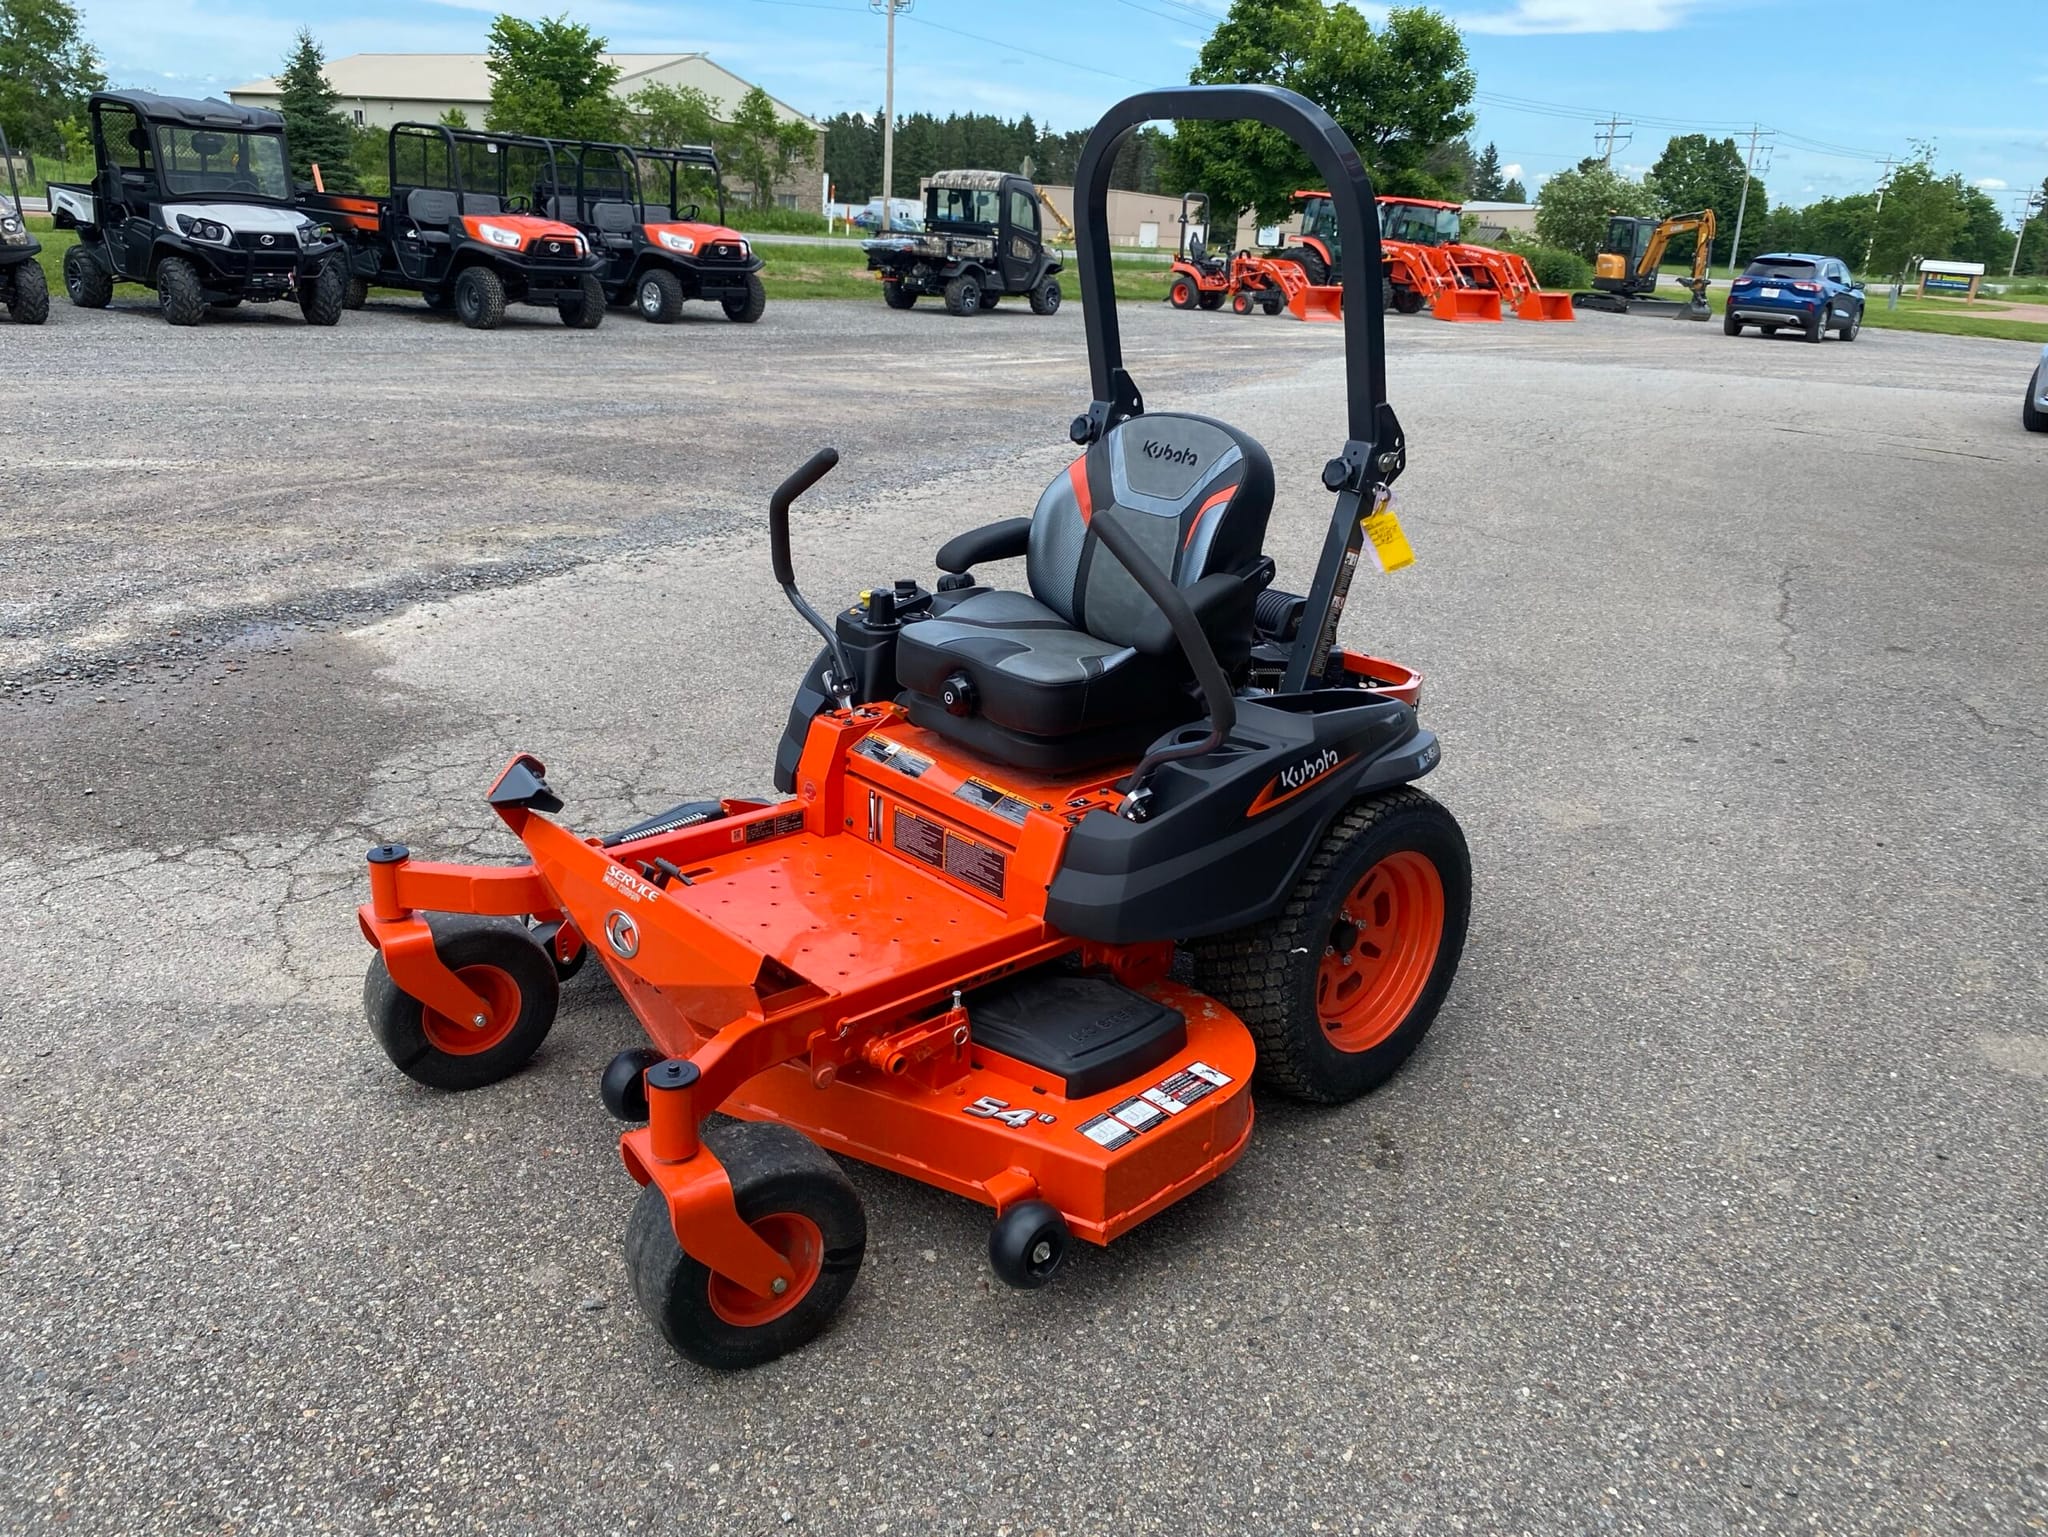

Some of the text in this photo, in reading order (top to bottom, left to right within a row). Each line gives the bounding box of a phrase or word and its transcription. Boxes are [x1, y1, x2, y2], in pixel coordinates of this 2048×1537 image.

[1143, 440, 1198, 466] Kubota
[1280, 749, 1339, 788] Kubota
[607, 865, 660, 903] SERVICE
